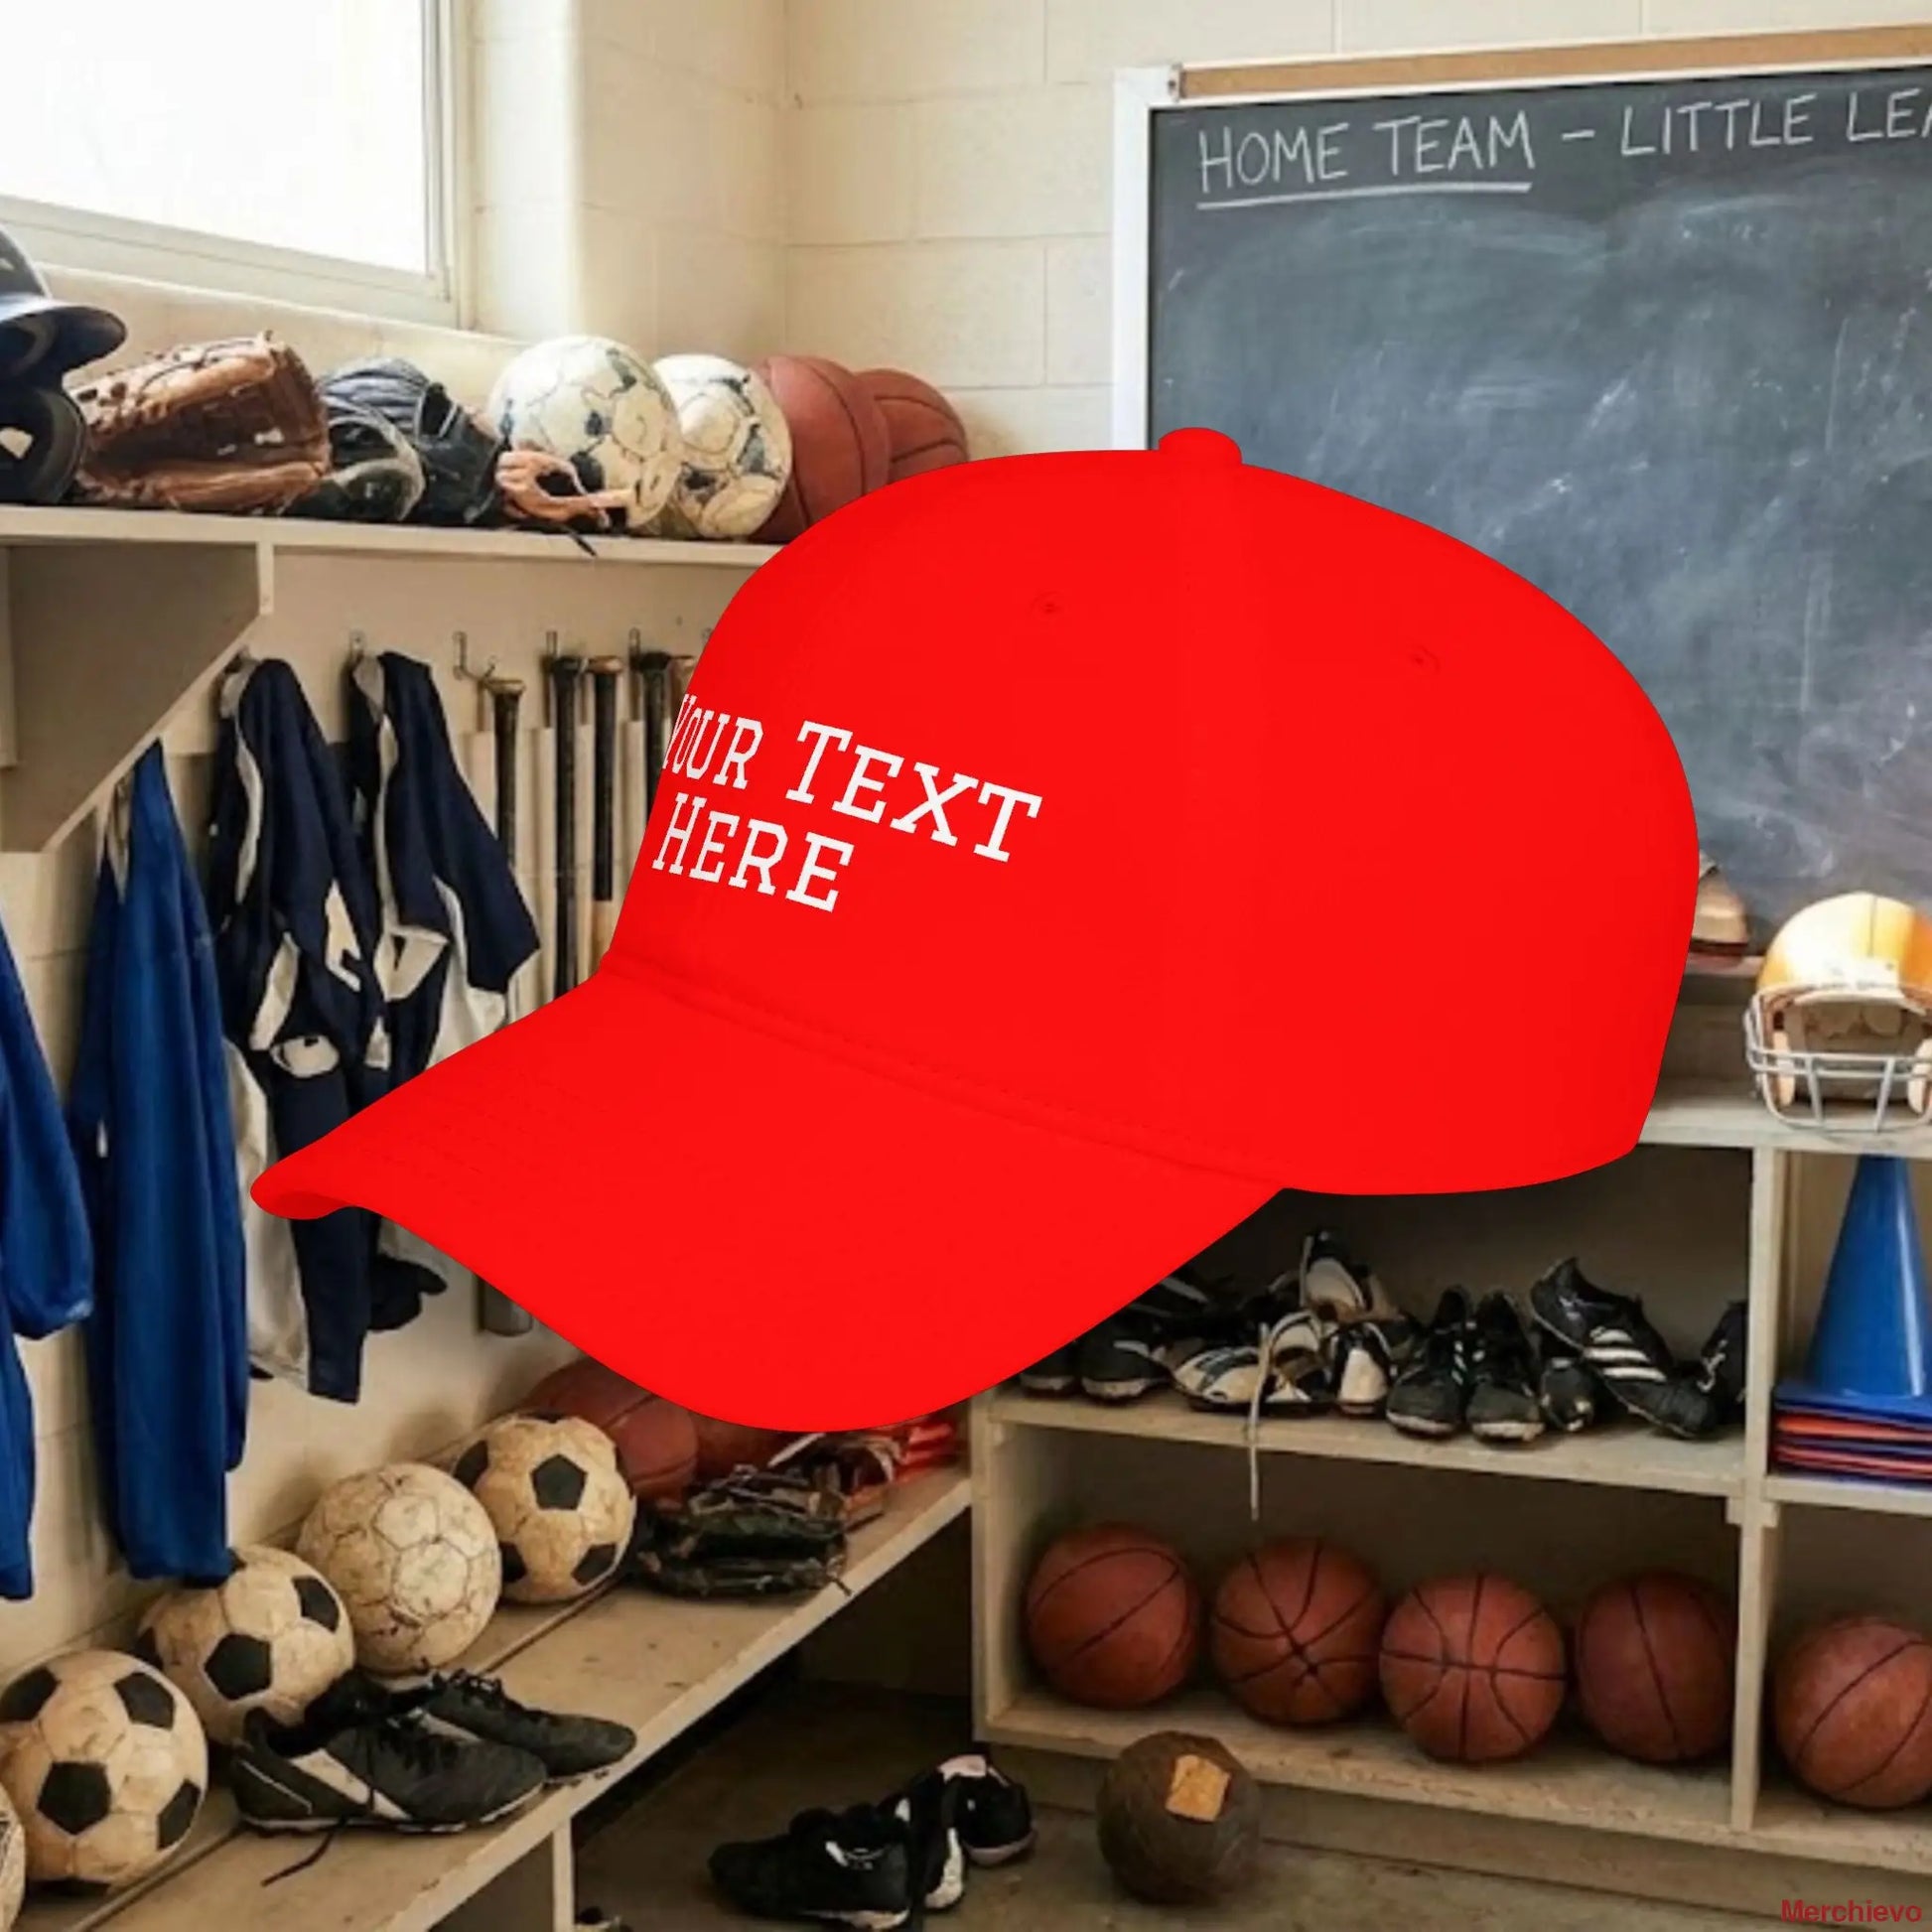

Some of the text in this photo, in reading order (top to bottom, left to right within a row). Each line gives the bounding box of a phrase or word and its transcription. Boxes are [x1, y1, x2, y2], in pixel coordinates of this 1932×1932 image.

[1198, 123, 1348, 193] HOME
[1373, 110, 1535, 175] TEAM
[1621, 94, 1815, 156] LITTLE
[662, 693, 1042, 863] YOUR TEXT
[651, 791, 855, 912] HERE
